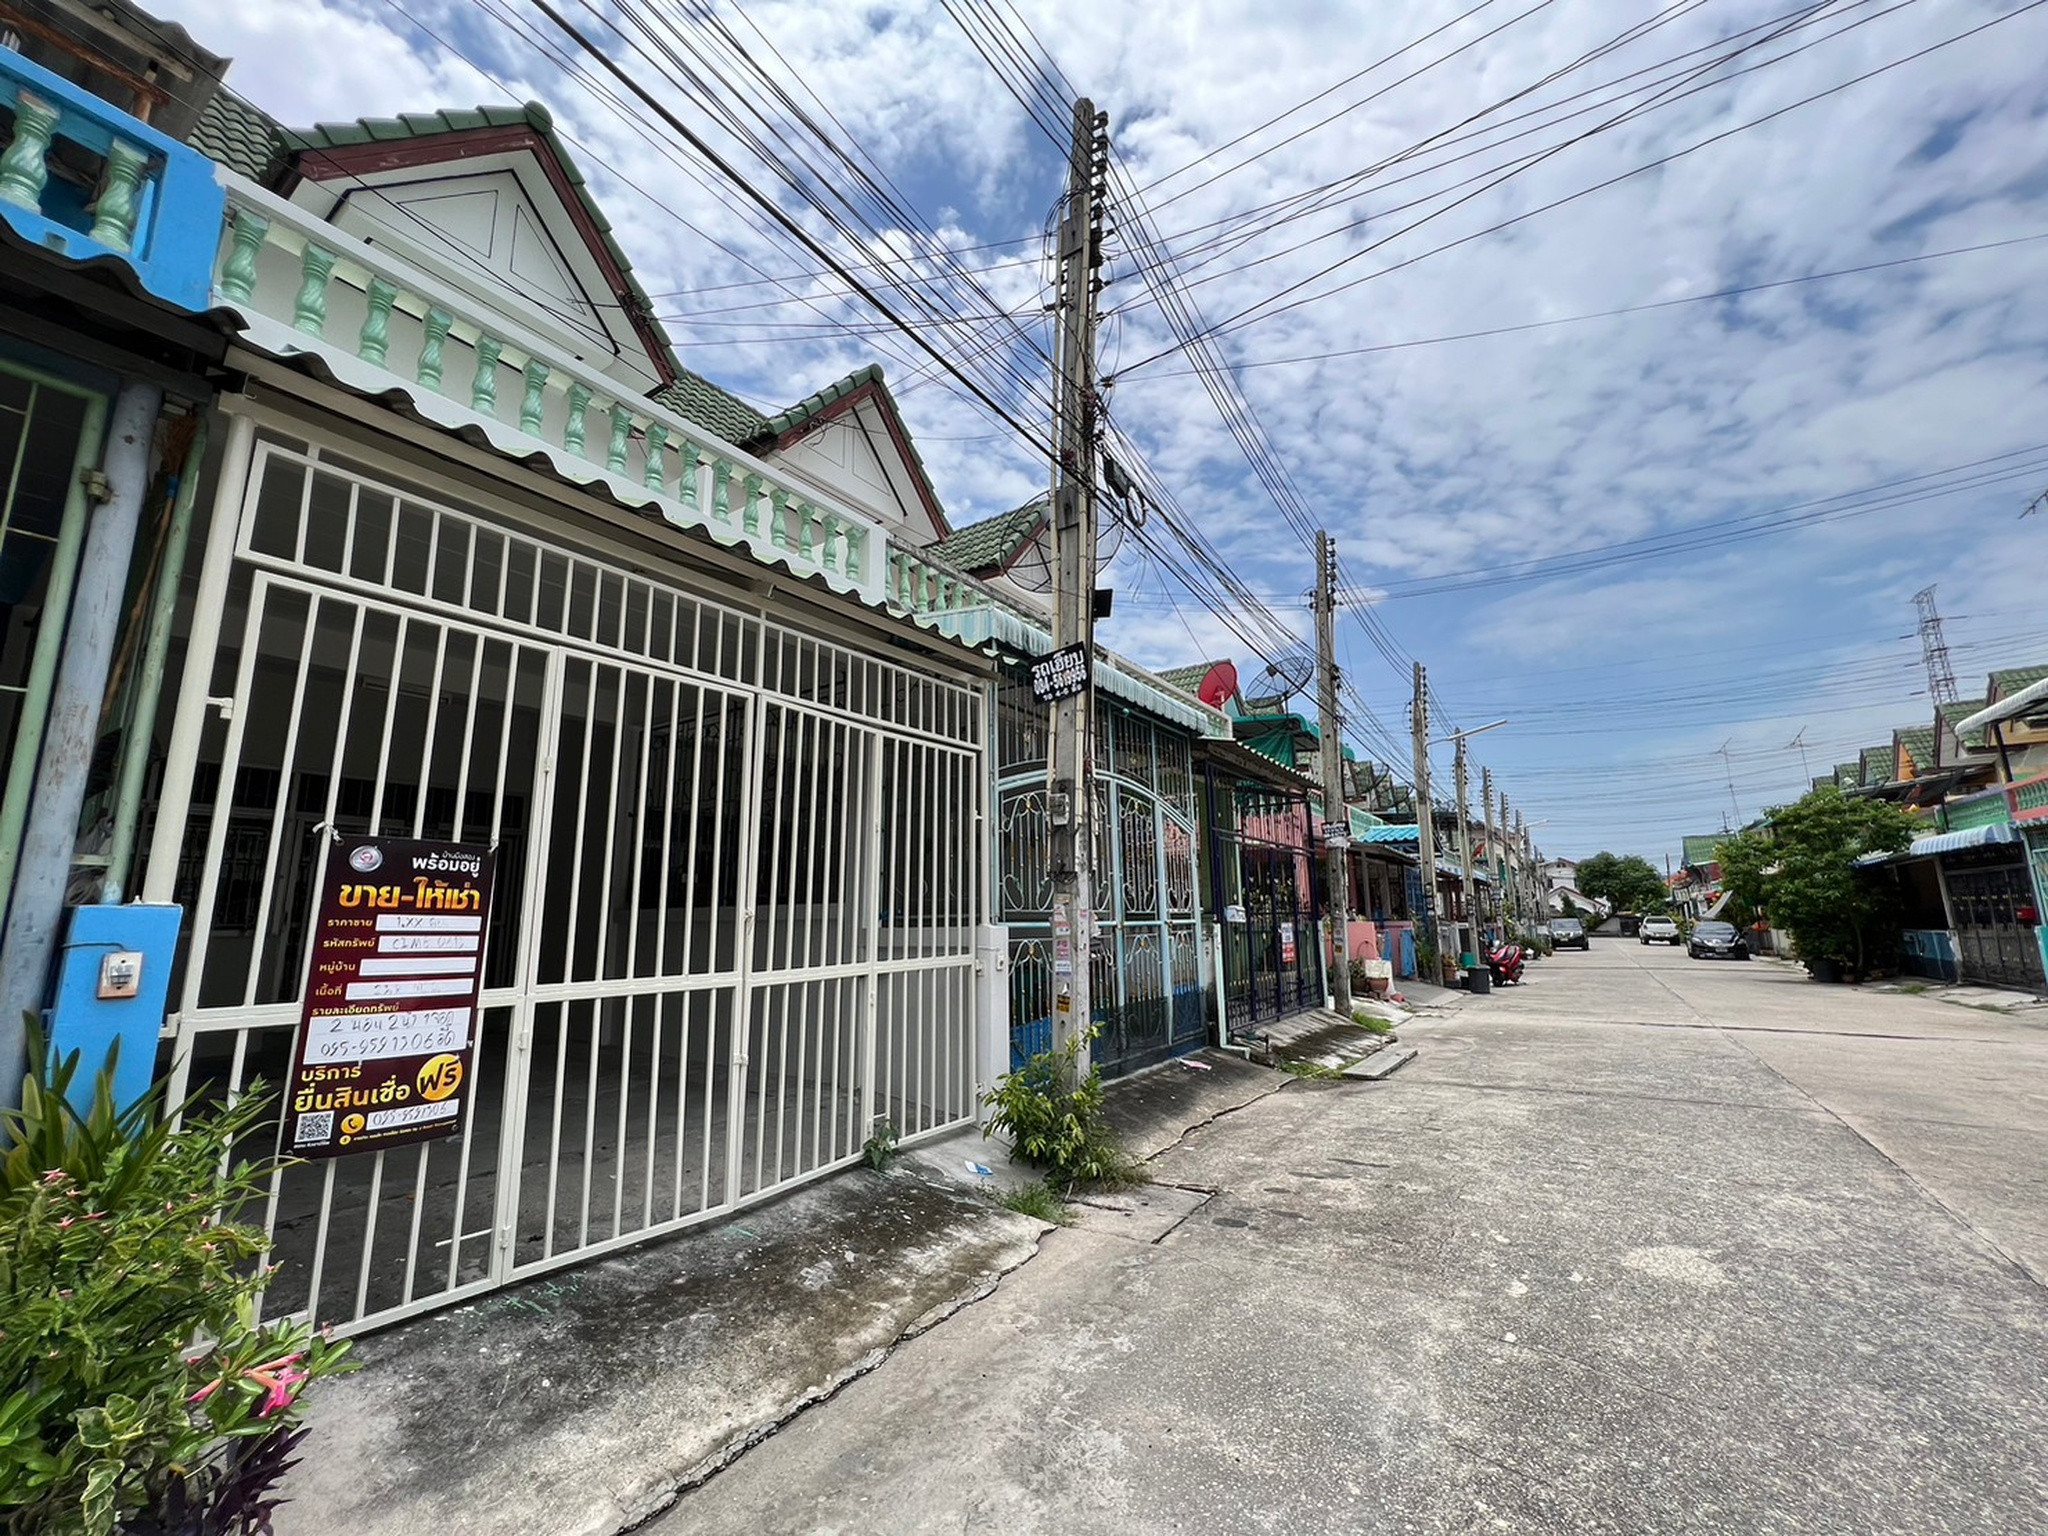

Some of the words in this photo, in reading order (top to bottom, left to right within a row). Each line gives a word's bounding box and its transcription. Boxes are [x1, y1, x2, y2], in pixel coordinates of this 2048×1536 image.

[442, 850, 476, 861] บ้านมือสอง
[412, 852, 481, 879] พร้อมอยู่
[339, 876, 481, 910] ขาย-ให้เช่า
[327, 918, 373, 928] ราคาขาย
[323, 937, 376, 948] รหัสทรัพย์
[319, 961, 356, 974] หมู่บ้าน
[315, 983, 342, 996] เนื้อที่
[312, 1003, 399, 1016] รายละเอียดทรัพย์
[330, 1018, 343, 1033] 2
[301, 1065, 362, 1082] บริการ
[420, 1060, 459, 1094] ฟรี
[294, 1075, 411, 1112] ยื่นสินเชื่อ
